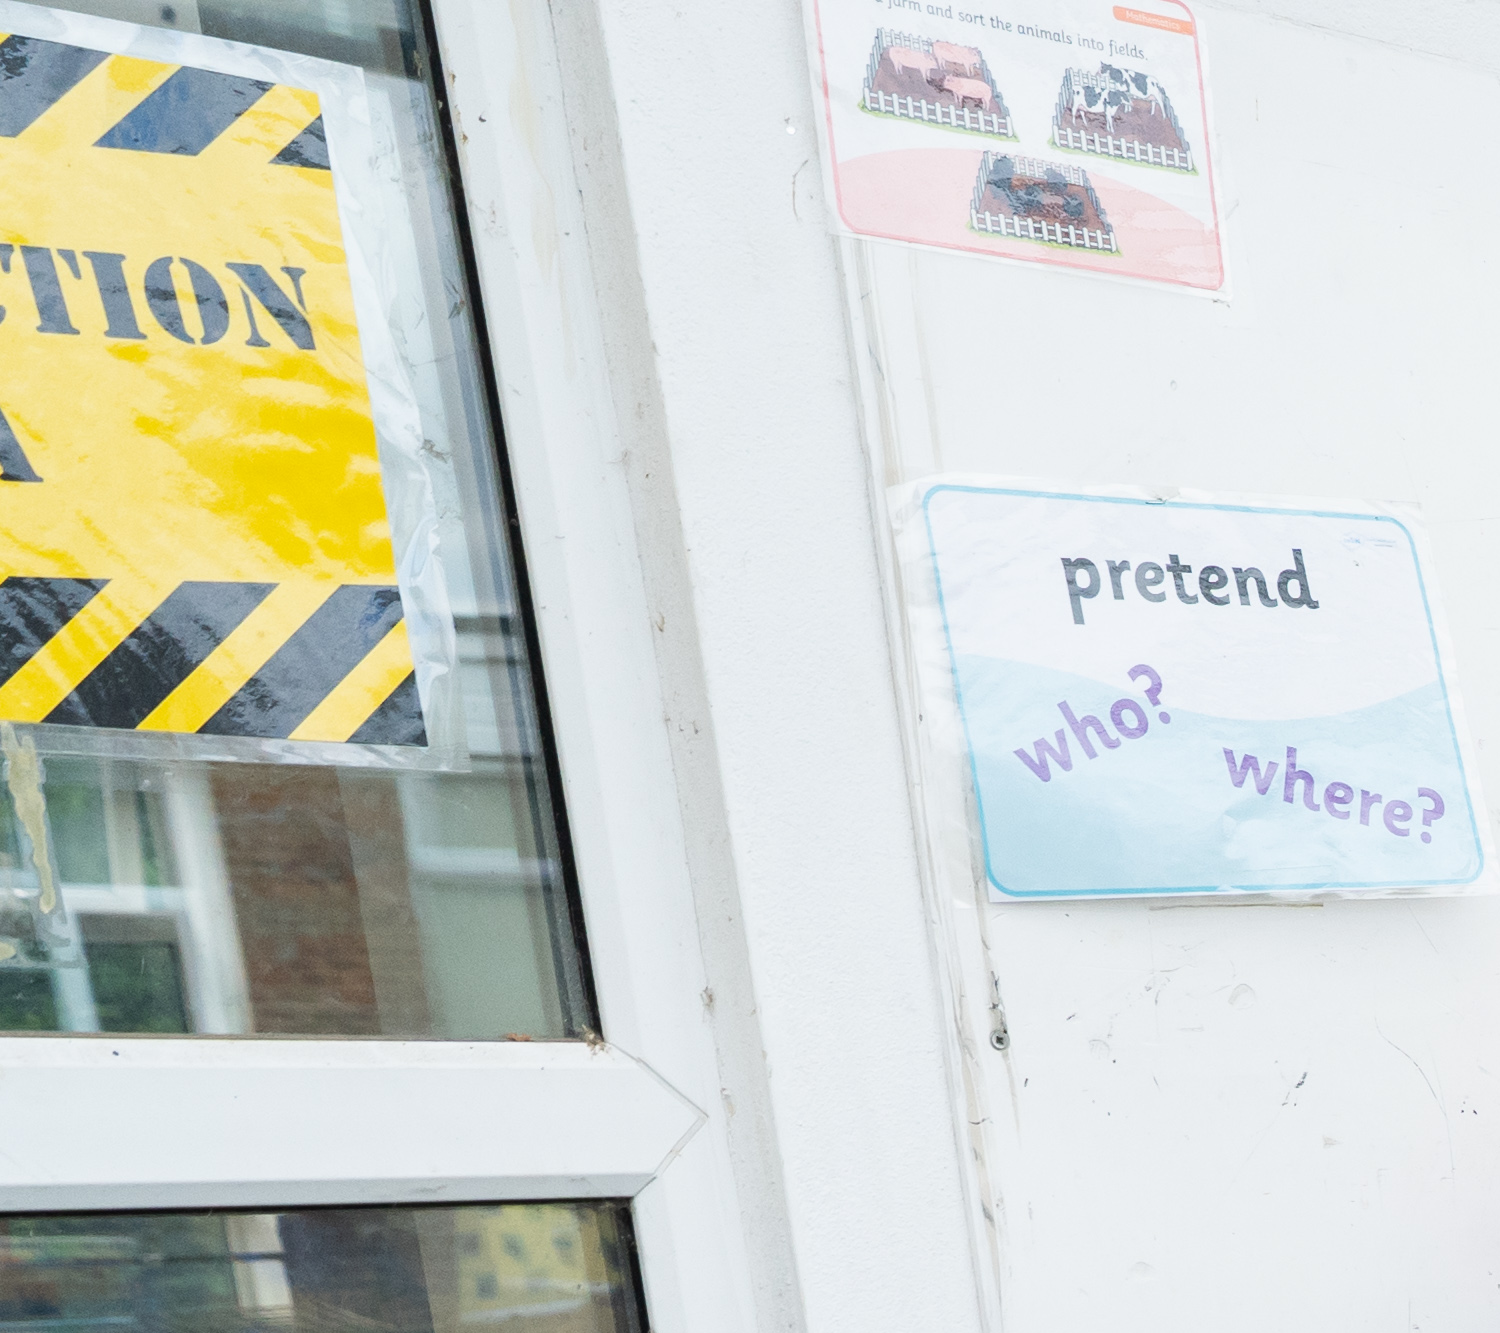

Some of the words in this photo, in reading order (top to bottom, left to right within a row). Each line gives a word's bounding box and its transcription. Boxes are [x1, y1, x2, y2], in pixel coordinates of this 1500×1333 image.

[927, 5, 953, 19] and
[958, 10, 985, 27] sort
[990, 16, 1012, 33] the
[1018, 22, 1073, 45] animals
[1077, 36, 1104, 52] into
[1109, 40, 1148, 61] fields.
[0, 243, 318, 350] TION
[1061, 549, 1320, 625] pretend
[1013, 663, 1171, 783] who?
[1222, 746, 1445, 844] where?
